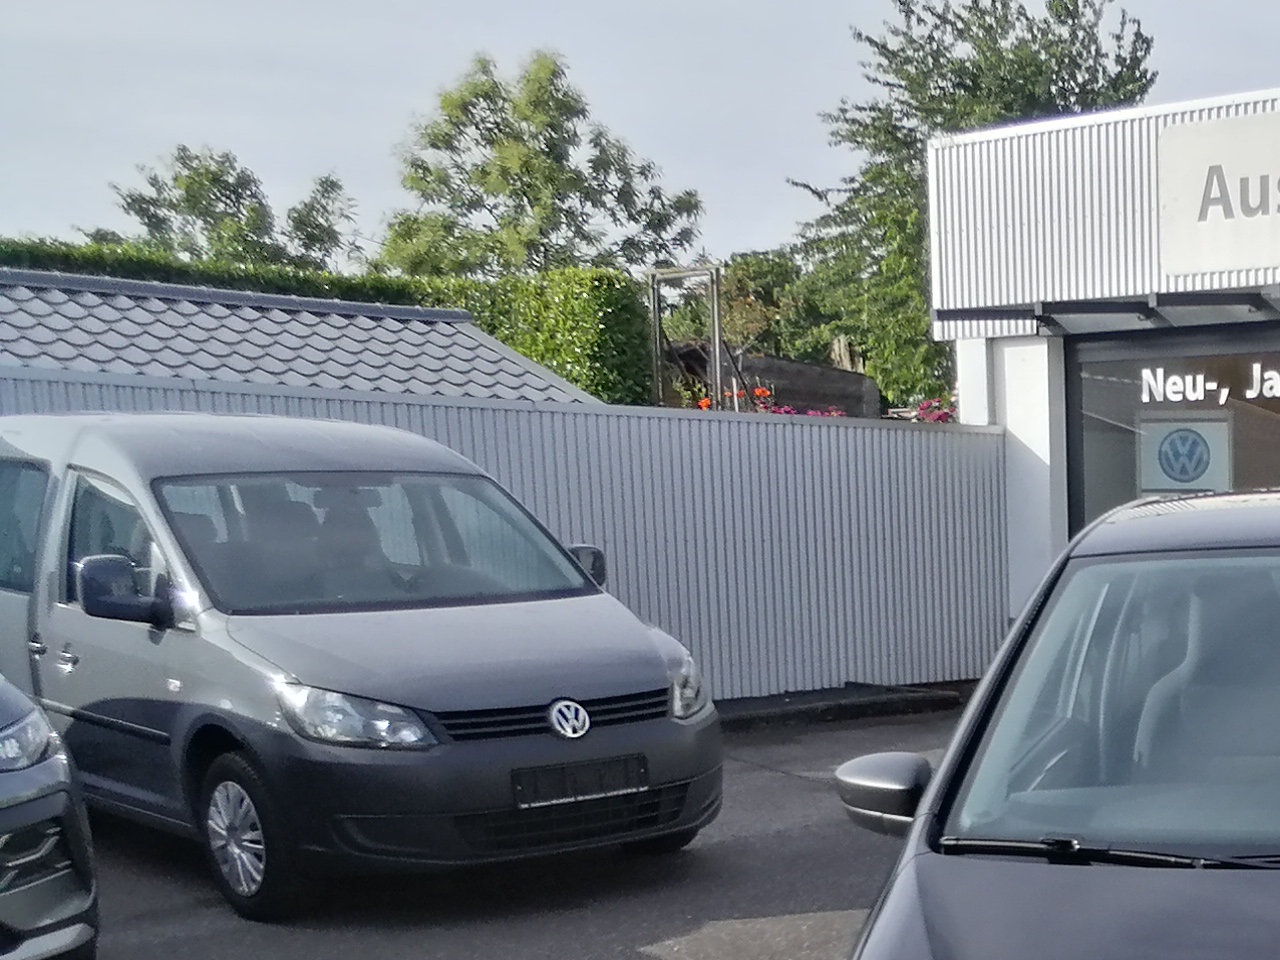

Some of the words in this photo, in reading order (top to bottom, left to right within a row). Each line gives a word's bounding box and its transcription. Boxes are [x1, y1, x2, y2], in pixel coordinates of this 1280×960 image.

[1141, 367, 1229, 406] Neu-,
[1160, 431, 1208, 480] VW
[552, 701, 590, 737] VW
